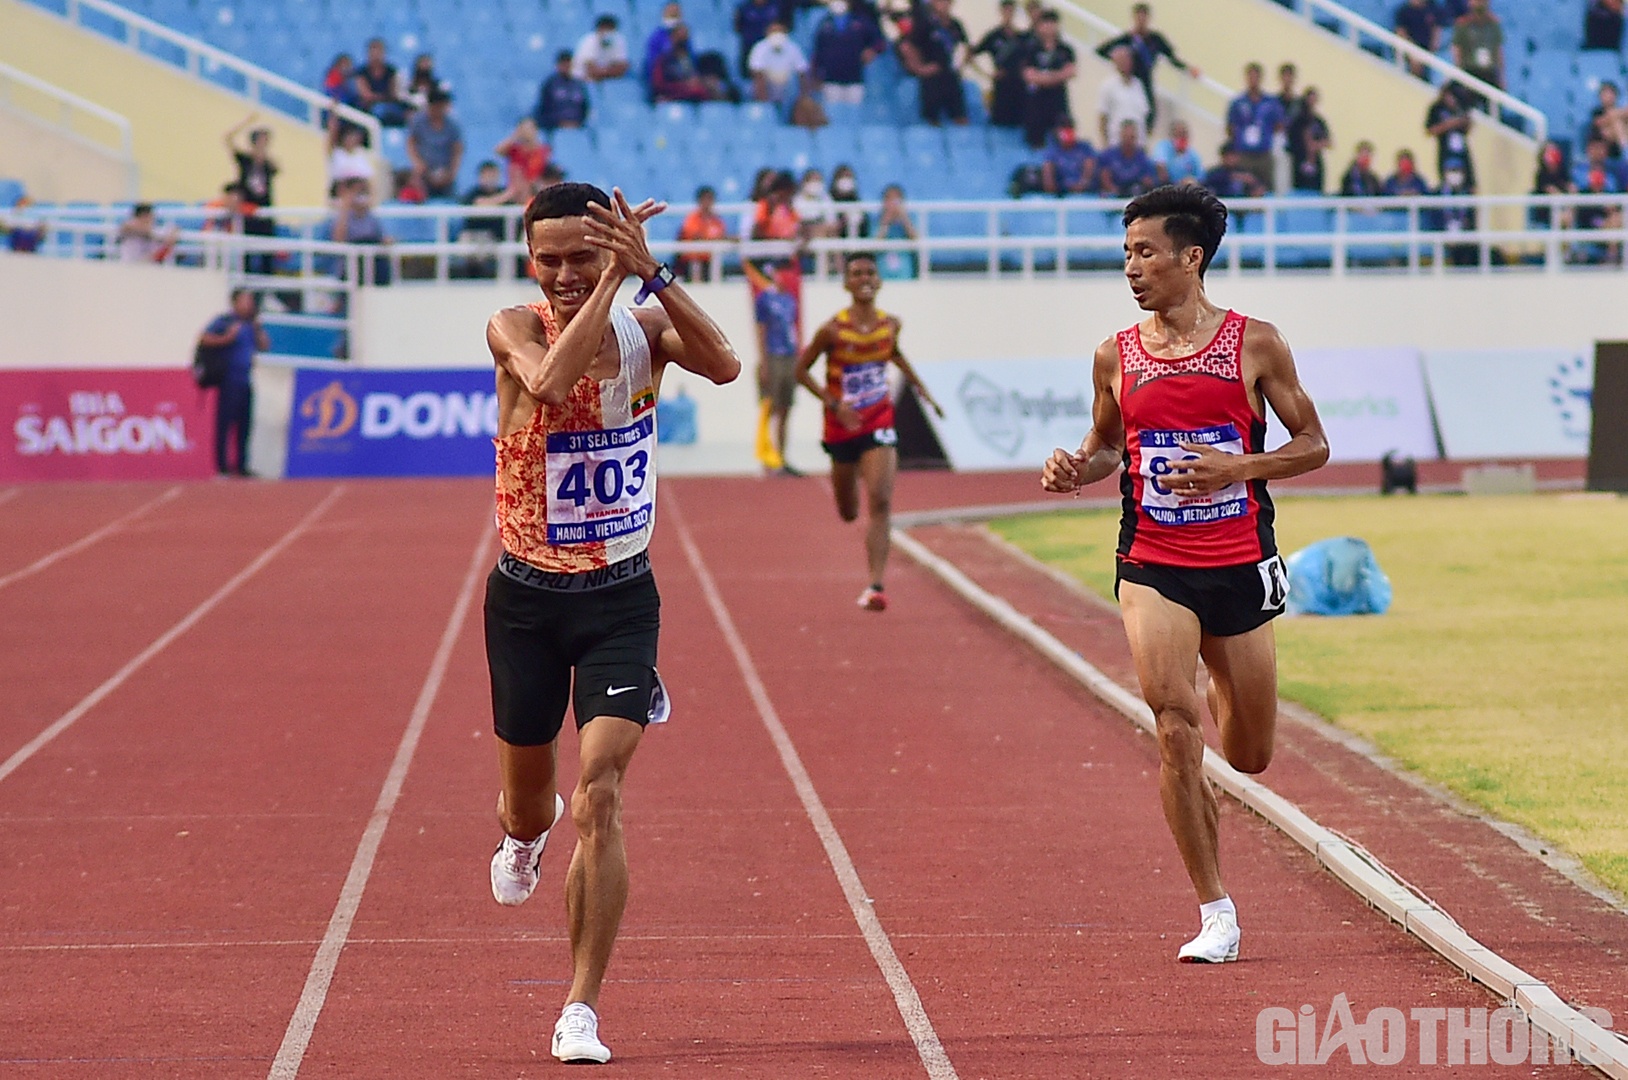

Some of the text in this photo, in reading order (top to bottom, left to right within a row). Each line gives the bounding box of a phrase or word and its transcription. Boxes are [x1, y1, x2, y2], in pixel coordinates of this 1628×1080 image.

[68, 391, 126, 415] BIA
[14, 414, 189, 454] SAIGON
[587, 433, 609, 449] SEA
[611, 427, 641, 445] Games
[1172, 432, 1191, 446] SEA
[1191, 430, 1222, 444] Games
[557, 450, 648, 508] 403
[1183, 507, 1219, 522] VIETNAM
[1220, 502, 1241, 518] 2022
[556, 526, 586, 541] HANOI
[594, 515, 633, 538] VIETNAM
[582, 559, 629, 589] NIKE
